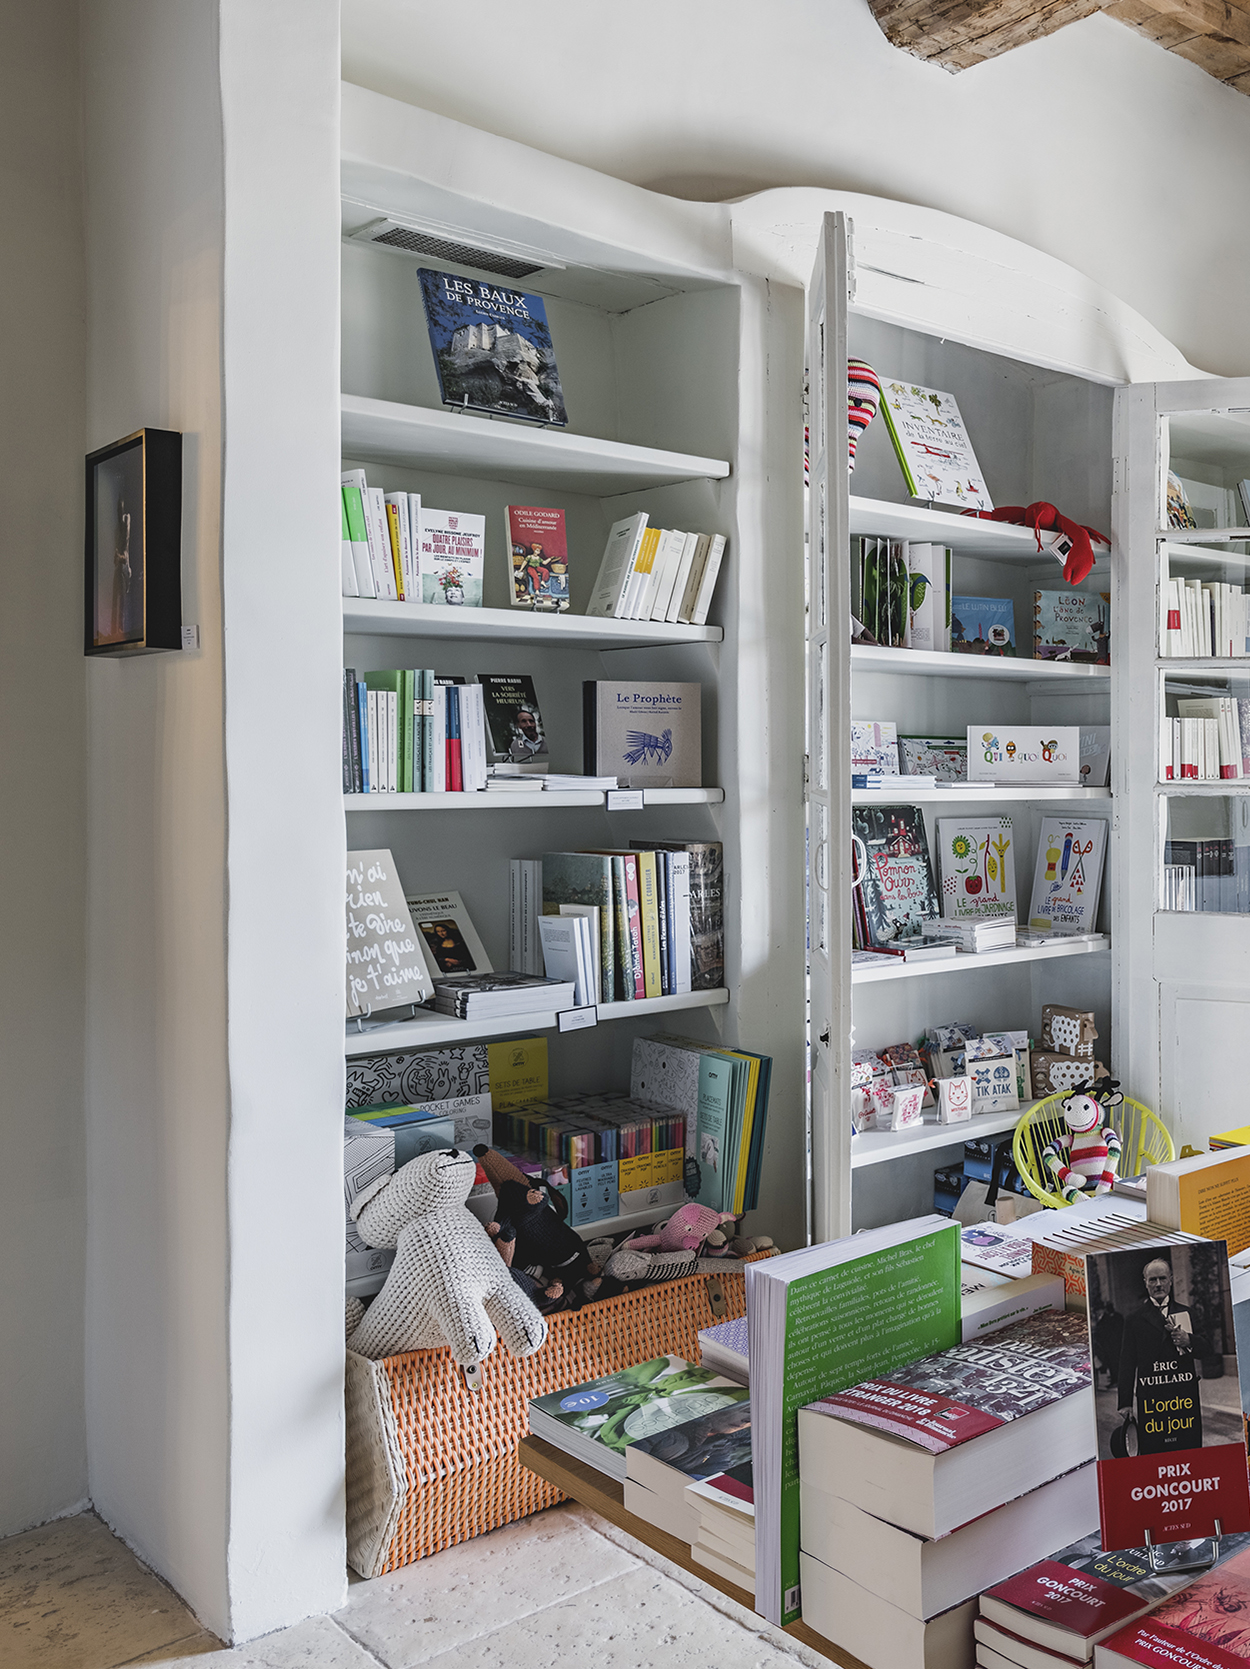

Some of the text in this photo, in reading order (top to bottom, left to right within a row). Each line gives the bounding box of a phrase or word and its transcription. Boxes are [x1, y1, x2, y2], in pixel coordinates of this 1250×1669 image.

[443, 278, 528, 309] LES BAUX
[446, 291, 462, 303] DE
[468, 297, 530, 320] PROVENCE
[901, 421, 965, 442] INVENTAIRE
[905, 430, 915, 438] de
[918, 431, 924, 440] la
[925, 434, 942, 445] terre
[955, 439, 967, 449] ciel
[534, 511, 560, 519] GODARD
[433, 534, 473, 547] QUATRE PLAISIRS
[422, 542, 432, 552] PAR
[448, 545, 454, 555] AU
[456, 546, 479, 558] MINIMUM
[990, 604, 1007, 612] BLEU
[617, 693, 682, 706] Le Prophète
[873, 852, 917, 883] Pompon
[689, 888, 720, 898] ARLES
[957, 893, 999, 907] LE grand
[1045, 893, 1072, 906] LE grand
[955, 908, 974, 916] LIVRE
[1037, 905, 1051, 914] LIVRE
[1057, 905, 1084, 915] BRICOLAGE
[366, 913, 405, 935] dire
[1060, 914, 1080, 923] ENFANTS
[630, 926, 642, 979] Djamel Tatah
[349, 975, 368, 1005] je
[522, 1076, 540, 1085] TABLE
[975, 1083, 1012, 1097] TIK ATAK
[420, 1097, 481, 1112] POCKET GAMES
[439, 1108, 467, 1117] COLORING
[790, 1284, 808, 1296] Dans
[819, 1273, 839, 1284] carnet
[851, 1260, 875, 1274] cuisine,
[877, 1253, 897, 1265] Michel
[899, 1248, 913, 1258] Bras,
[922, 1239, 936, 1250] chef
[790, 1254, 924, 1307] mythique de Laguiole, et son fils Sébastien
[789, 1301, 820, 1317] célèbrent
[829, 1283, 868, 1302] convivialité.
[990, 1340, 1068, 1359] paul
[945, 1347, 1078, 1386] auster
[1153, 1359, 1179, 1372] ÉRIC
[1139, 1371, 1193, 1387] VUILLARD
[857, 1382, 938, 1407] PRIX DU LIVRE
[980, 1375, 1045, 1406] 4321
[579, 1395, 599, 1405] 10
[1144, 1396, 1193, 1414] L'ordre
[897, 1403, 932, 1416] 2018
[1145, 1416, 1195, 1435] du jour
[1158, 1463, 1191, 1479] PRIX
[1130, 1476, 1221, 1501] GONCOURT
[1161, 1498, 1193, 1513] 2017
[1162, 1522, 1191, 1532] ACTES SUD
[1094, 1563, 1135, 1582] du jour
[1107, 1554, 1147, 1575] L'ordre
[1036, 1577, 1106, 1608] GONCOURT
[1068, 1578, 1098, 1592] PRIX
[1044, 1591, 1073, 1604] 2017
[1135, 1638, 1153, 1649] PRIX
[1137, 1629, 1211, 1665] Par l'auteur de L'Ordre
